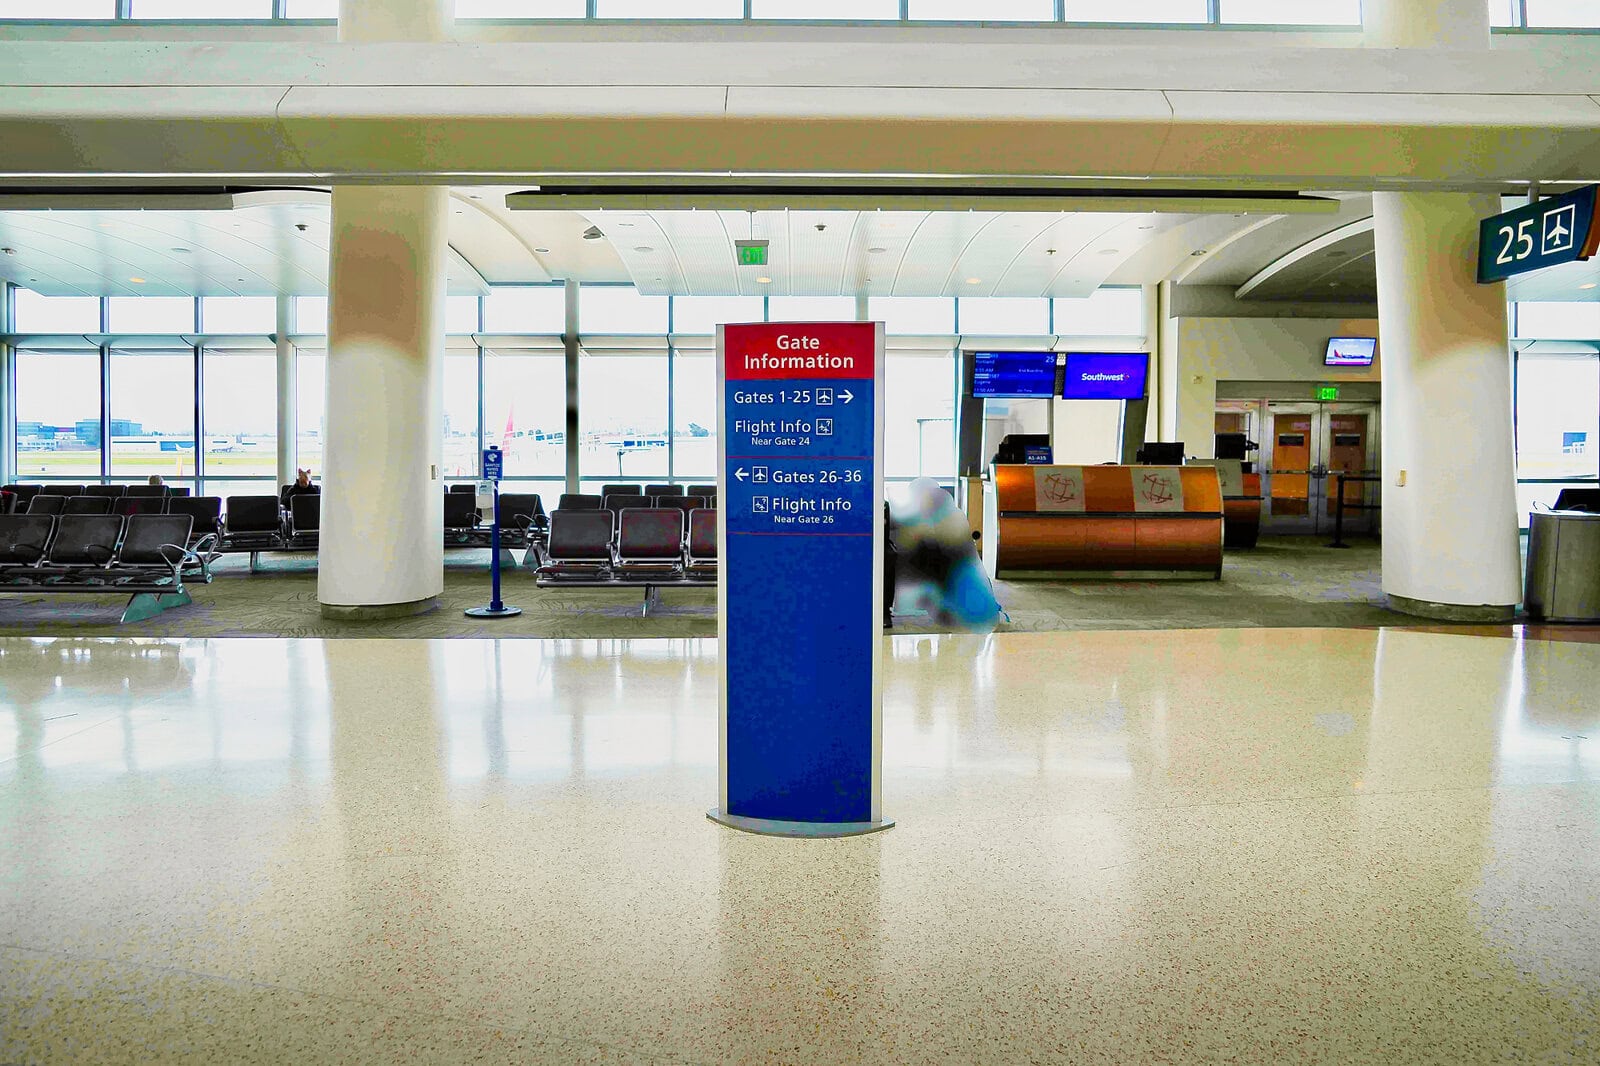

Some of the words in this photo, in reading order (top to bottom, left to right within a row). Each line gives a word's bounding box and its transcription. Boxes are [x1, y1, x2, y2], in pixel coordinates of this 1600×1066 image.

[1496, 219, 1534, 265] 25
[776, 335, 820, 350] Gate
[744, 353, 854, 369] Information
[1081, 373, 1124, 381] Southwest
[734, 391, 774, 404] Gates
[779, 390, 811, 404] 1-25
[735, 420, 776, 436] Flight
[781, 420, 811, 433] Info
[751, 437, 772, 446] Near
[774, 437, 796, 446] Gate
[798, 437, 810, 446] 24
[772, 470, 815, 484] Gates
[819, 470, 862, 483] 26-36
[772, 498, 816, 514] Flight
[821, 498, 852, 511] Info
[774, 515, 795, 524] Near
[798, 515, 820, 524] Gate
[822, 515, 834, 524] 26
